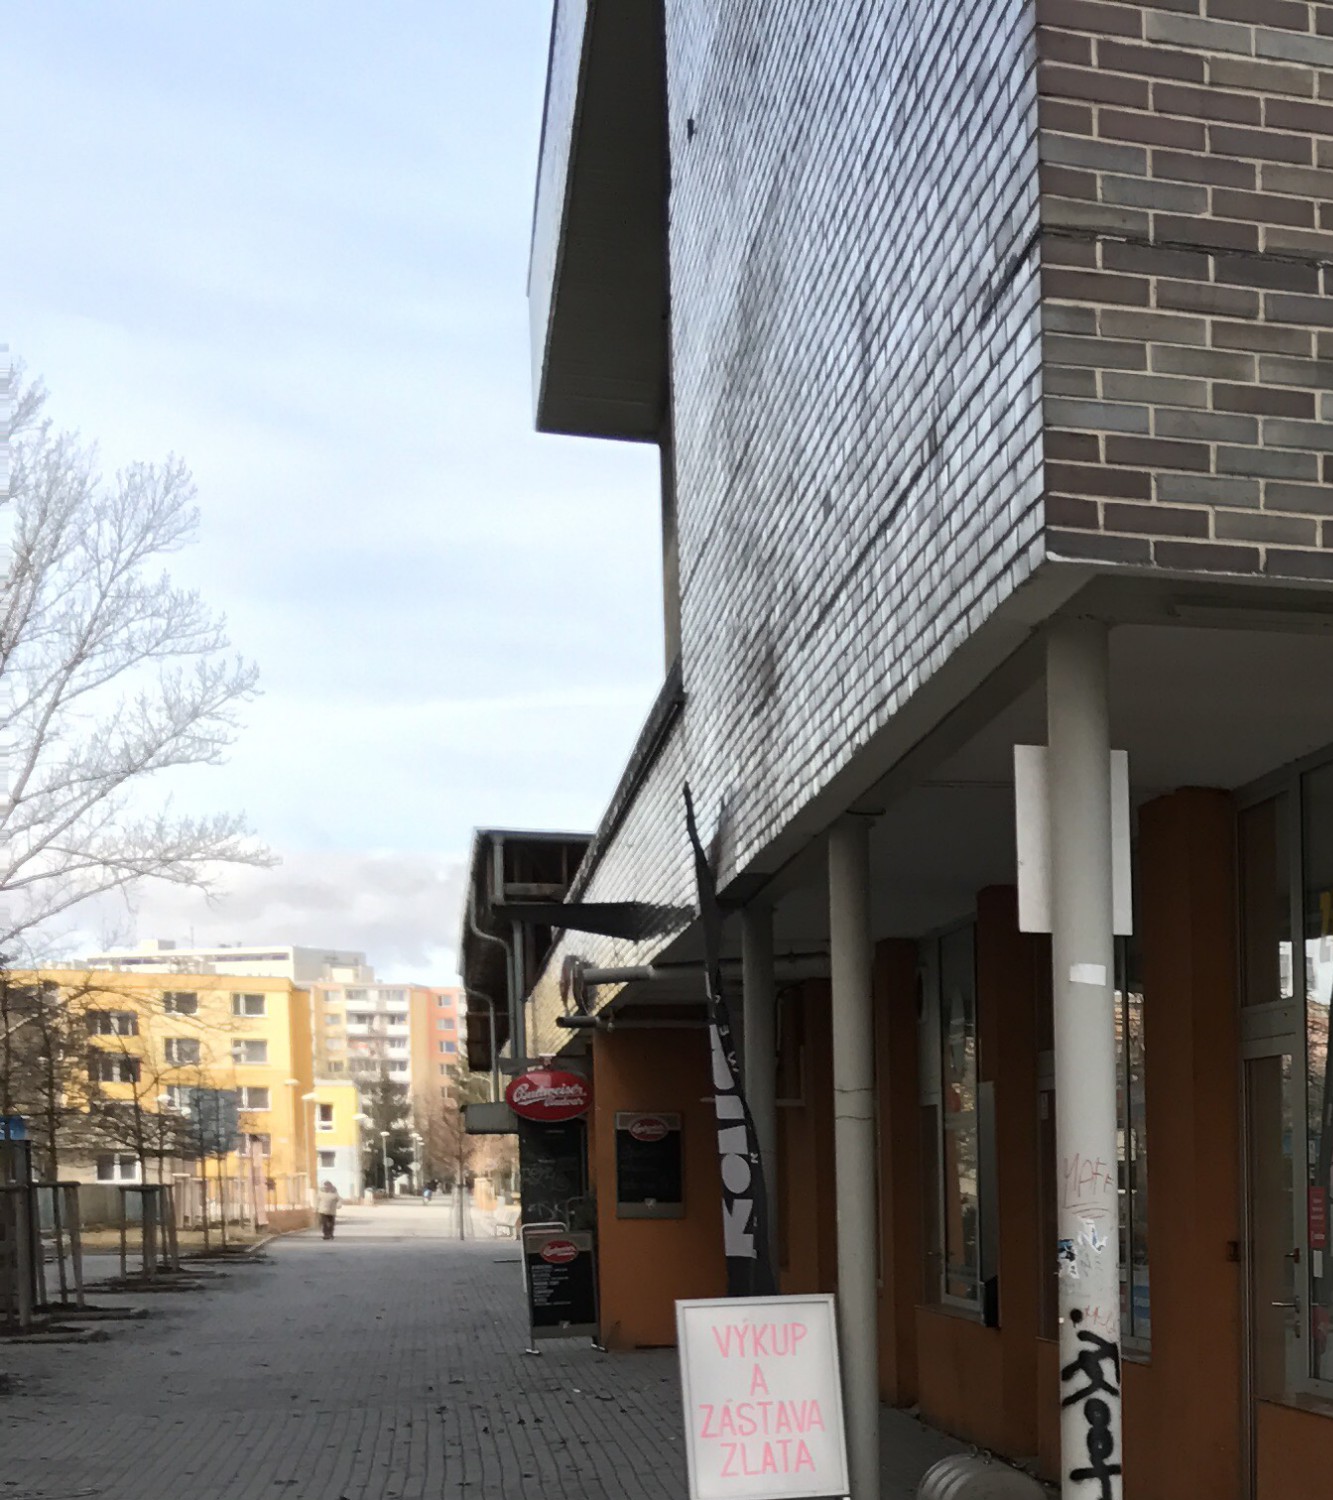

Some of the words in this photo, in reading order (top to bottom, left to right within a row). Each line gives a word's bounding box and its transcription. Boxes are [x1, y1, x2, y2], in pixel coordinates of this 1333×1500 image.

[712, 1318, 808, 1359] VÝKUP
[749, 1363, 770, 1397] A
[719, 1439, 817, 1479] ZLATA
